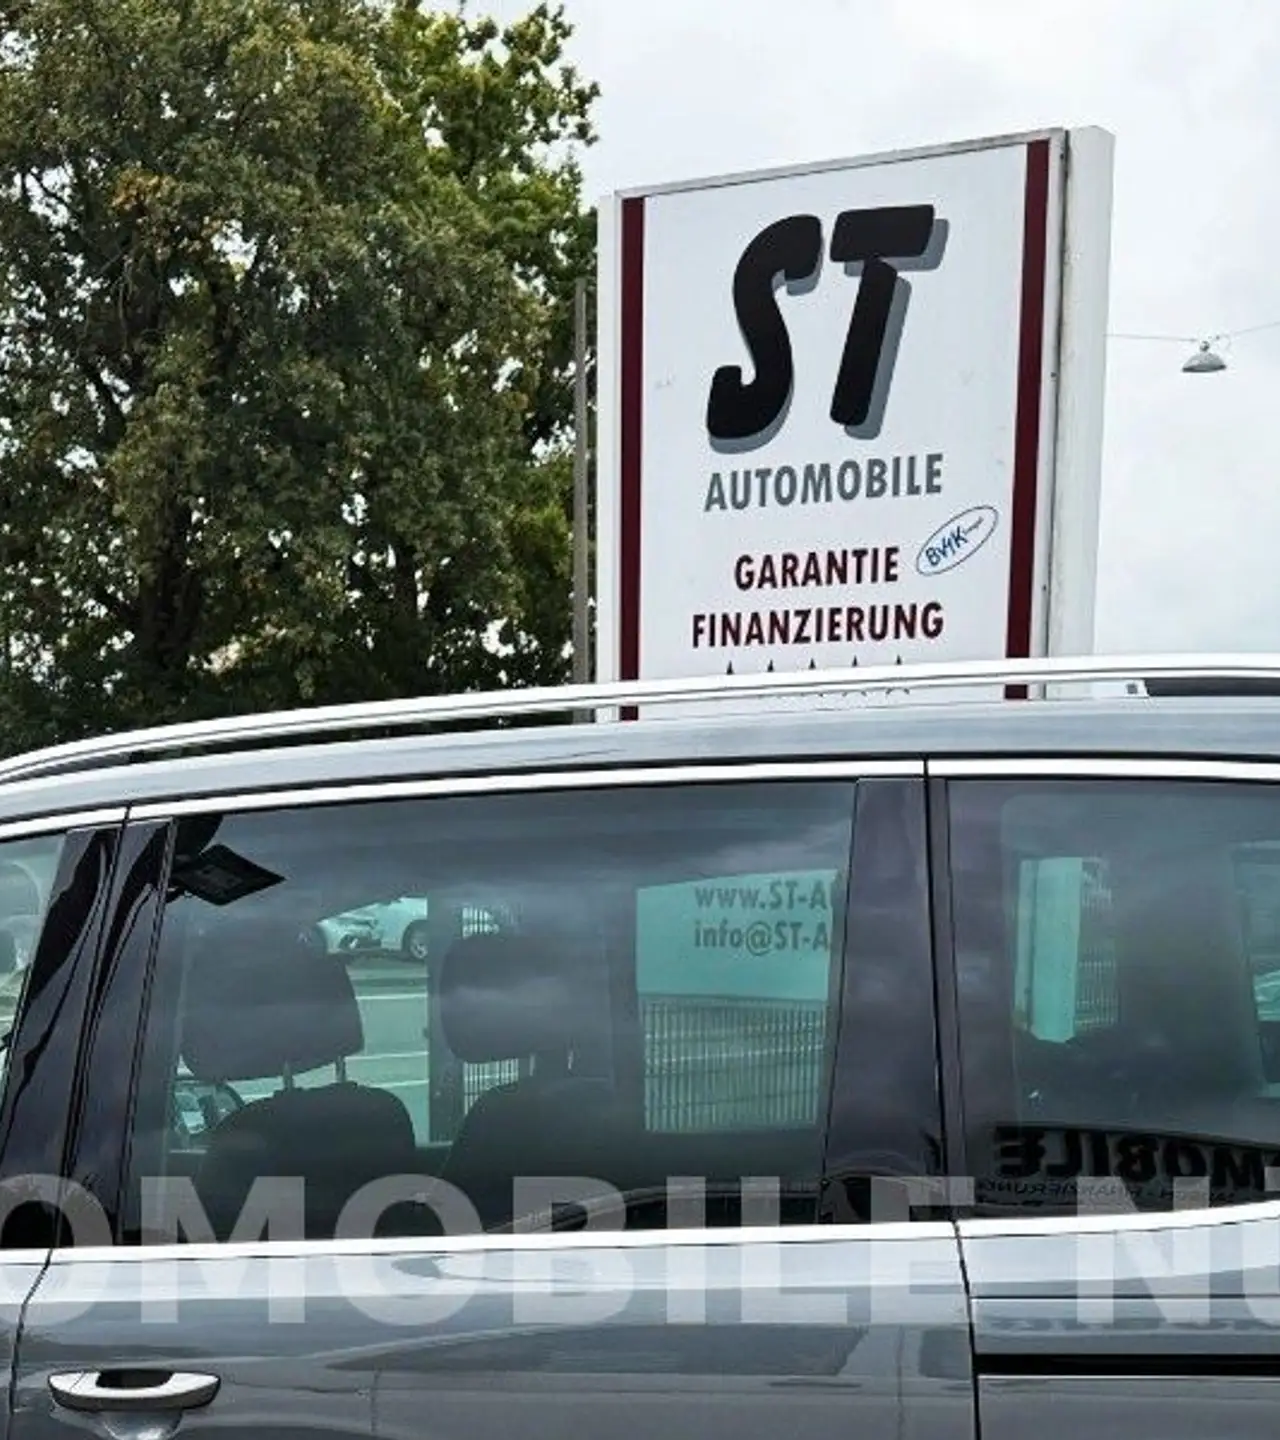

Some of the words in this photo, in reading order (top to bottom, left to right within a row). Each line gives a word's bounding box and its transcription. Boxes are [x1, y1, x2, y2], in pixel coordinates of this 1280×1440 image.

[706, 203, 949, 454] ST
[703, 453, 944, 512] AUTOMOBILE
[735, 546, 901, 591] GARANTIE
[692, 602, 945, 649] FINANZIERUNG
